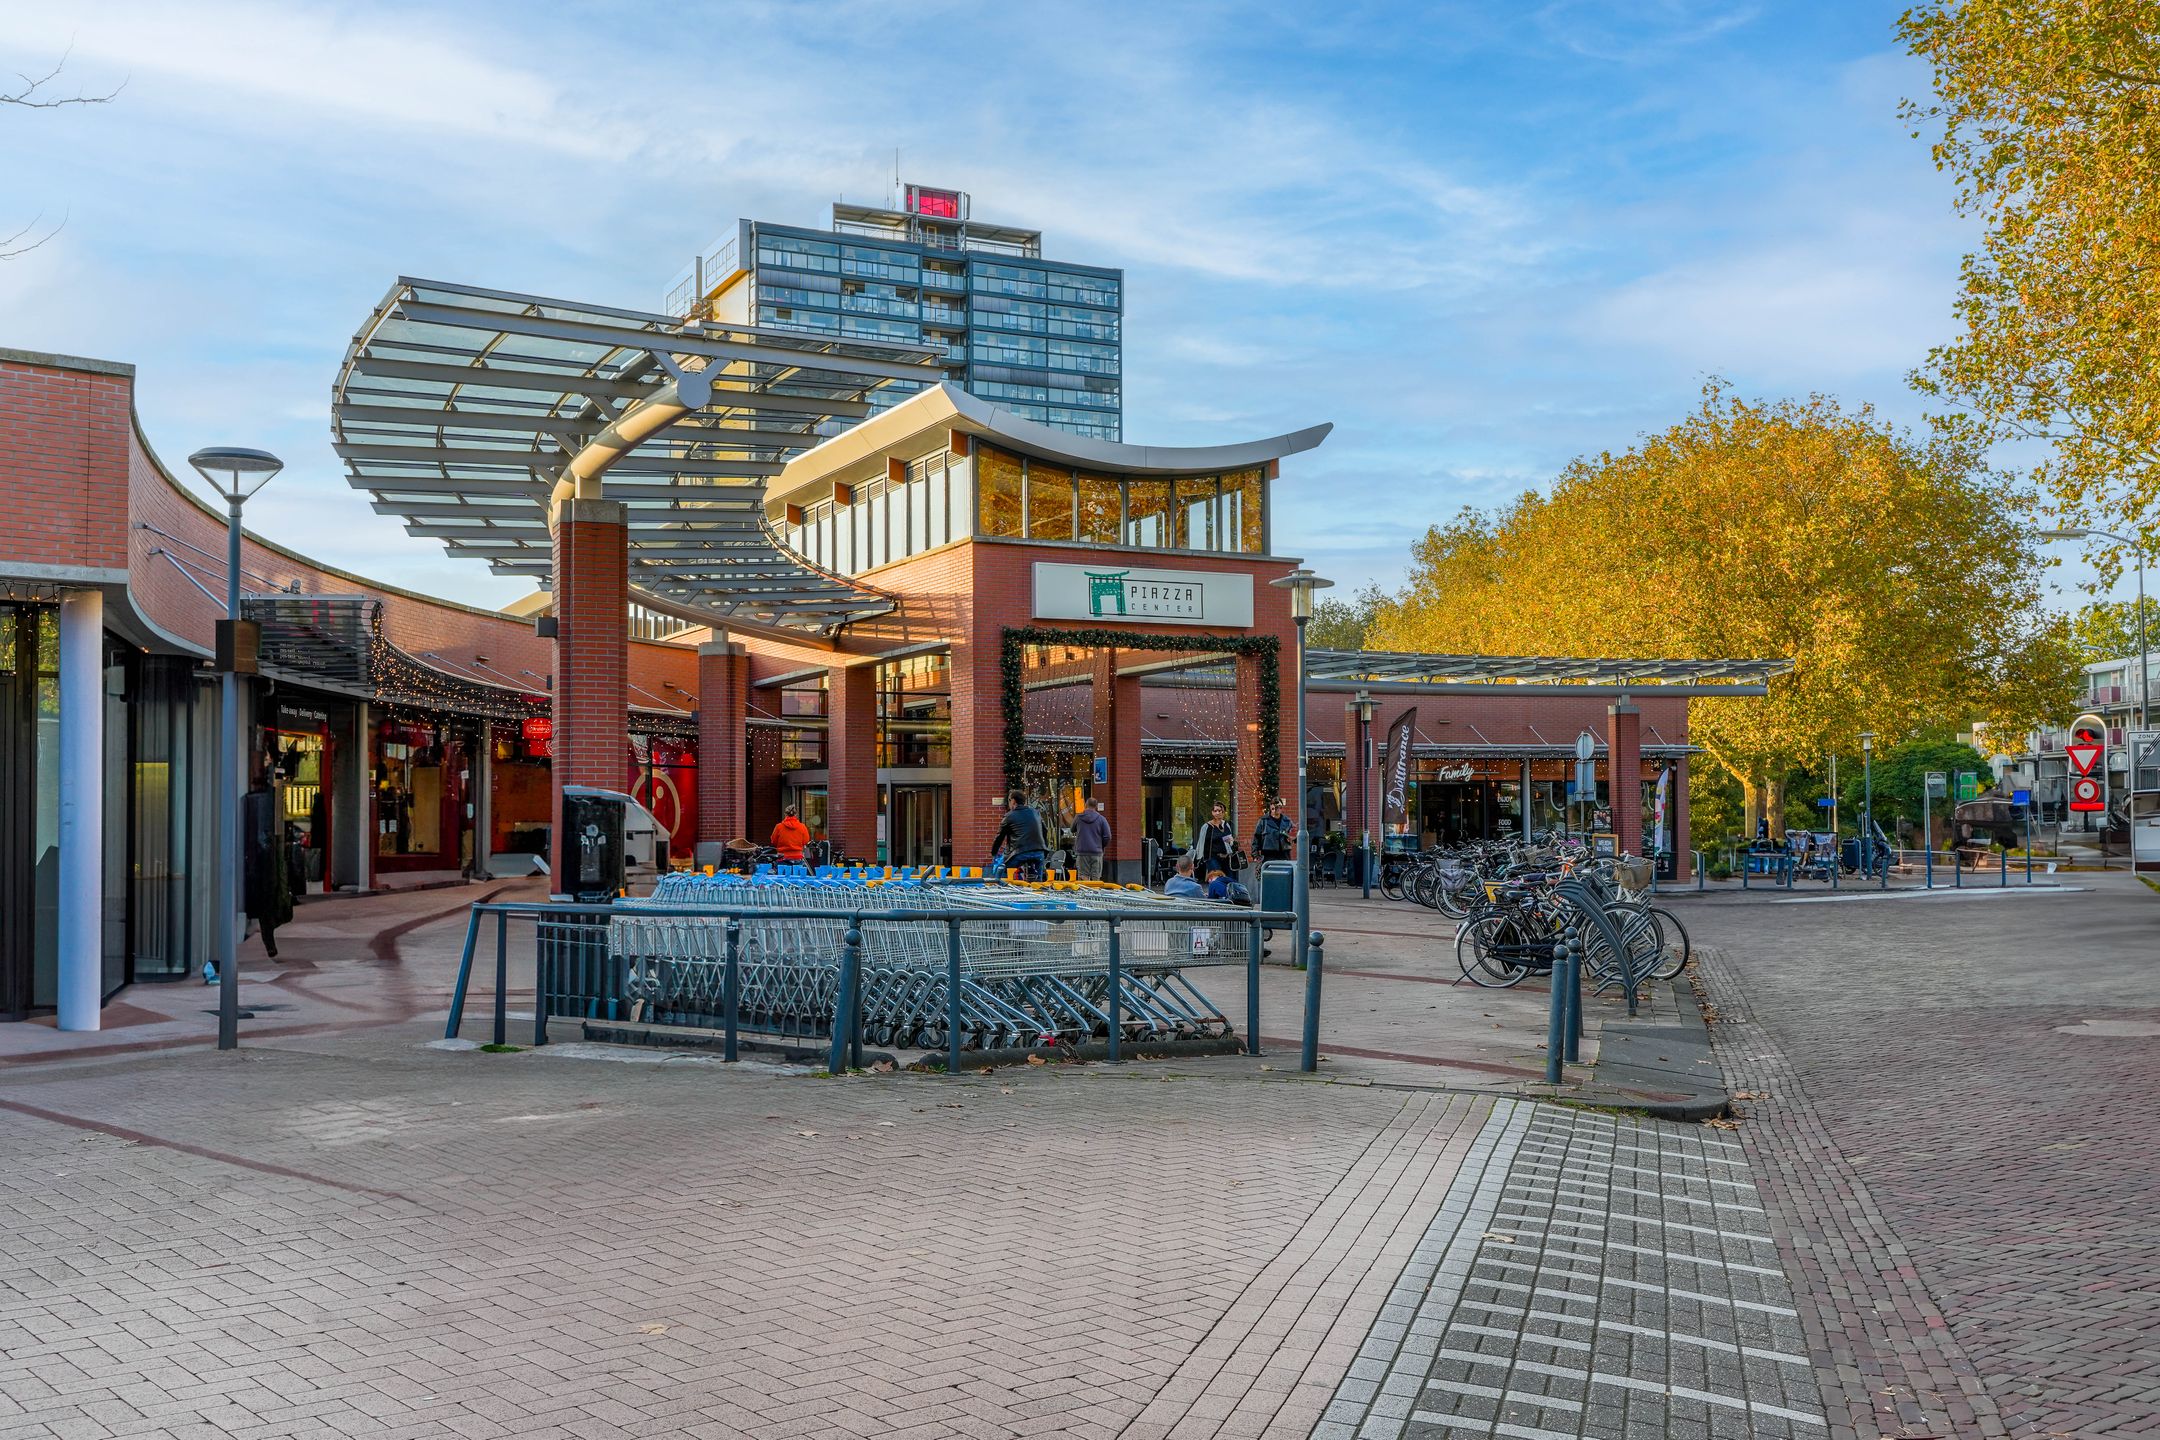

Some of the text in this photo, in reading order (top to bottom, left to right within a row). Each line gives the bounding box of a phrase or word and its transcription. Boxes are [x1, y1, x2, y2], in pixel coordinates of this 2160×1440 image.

[1131, 586, 1192, 601] PIAZZA
[1131, 602, 1193, 613] CENTER
[1439, 762, 1475, 781] Family
